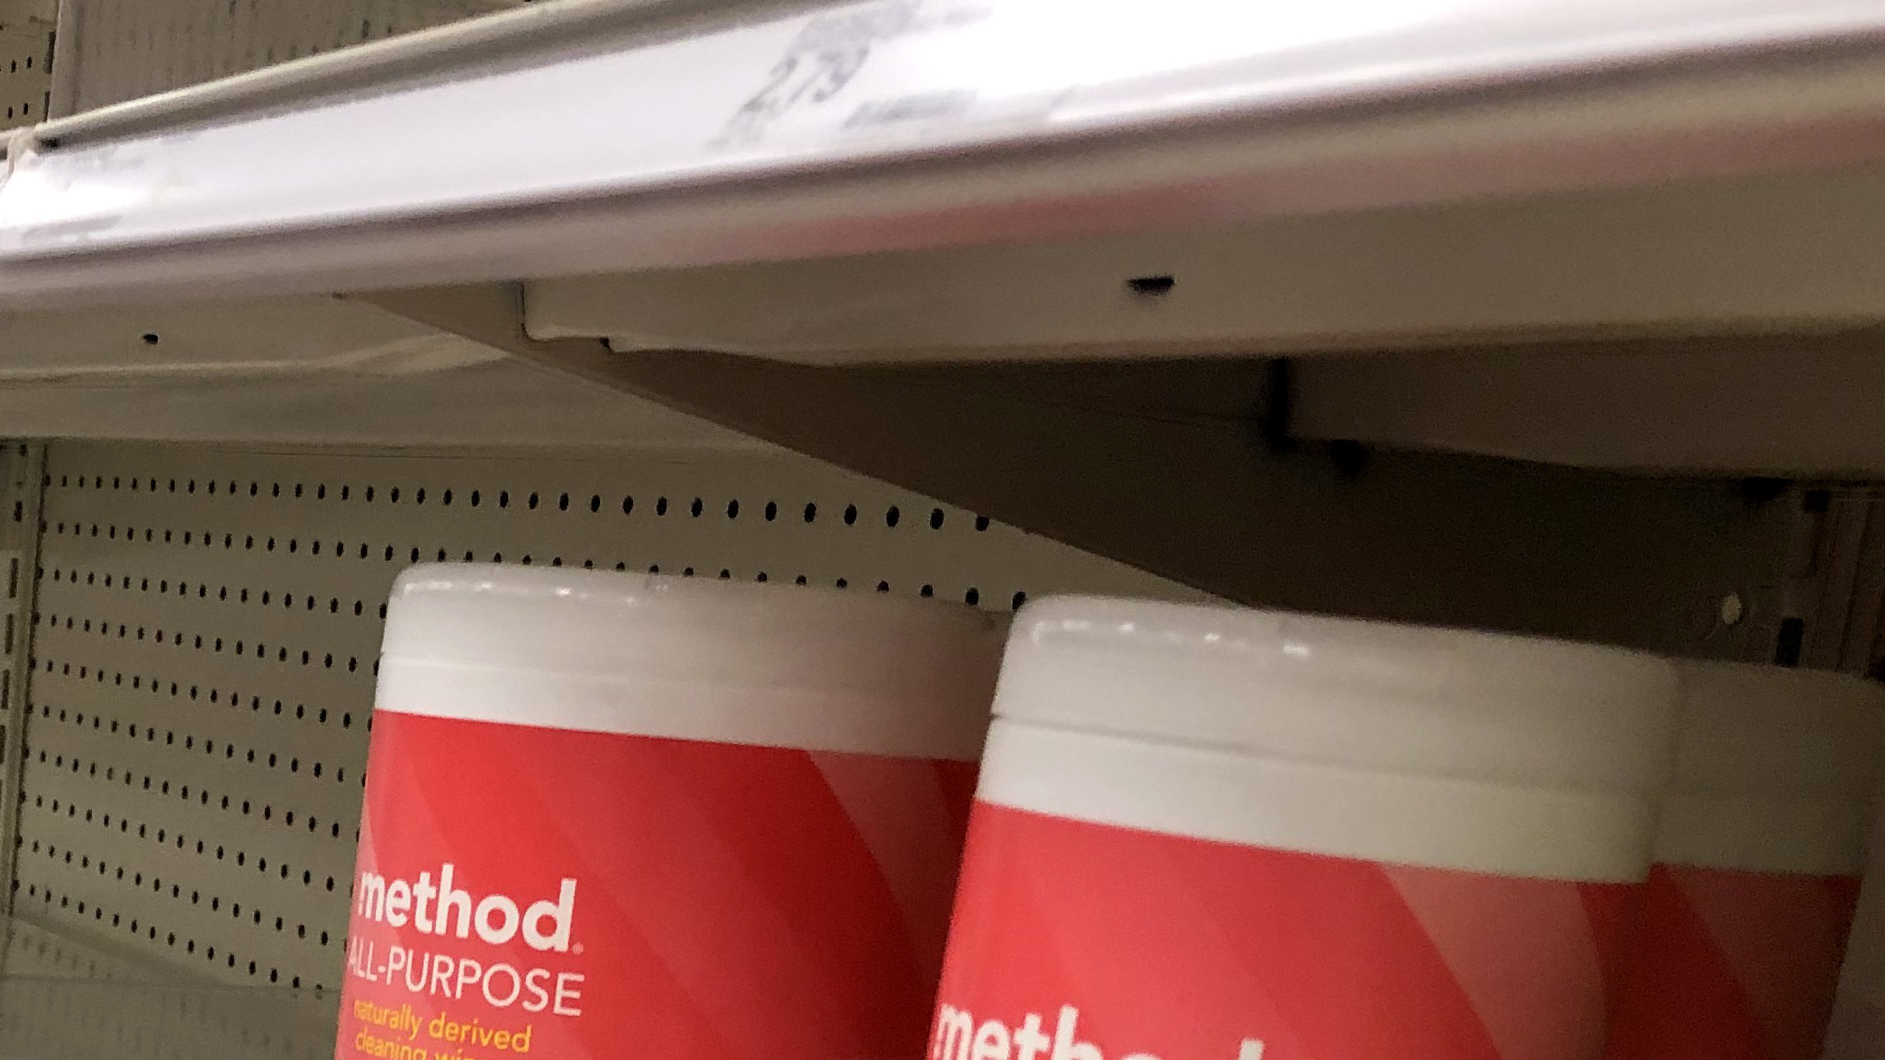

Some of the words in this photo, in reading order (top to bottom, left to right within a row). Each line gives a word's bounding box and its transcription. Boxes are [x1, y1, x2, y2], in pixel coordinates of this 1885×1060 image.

[358, 863, 577, 953] method
[348, 936, 585, 1016] ALL-PURPOSE
[354, 999, 423, 1041] naturally
[429, 1011, 532, 1053] derived
